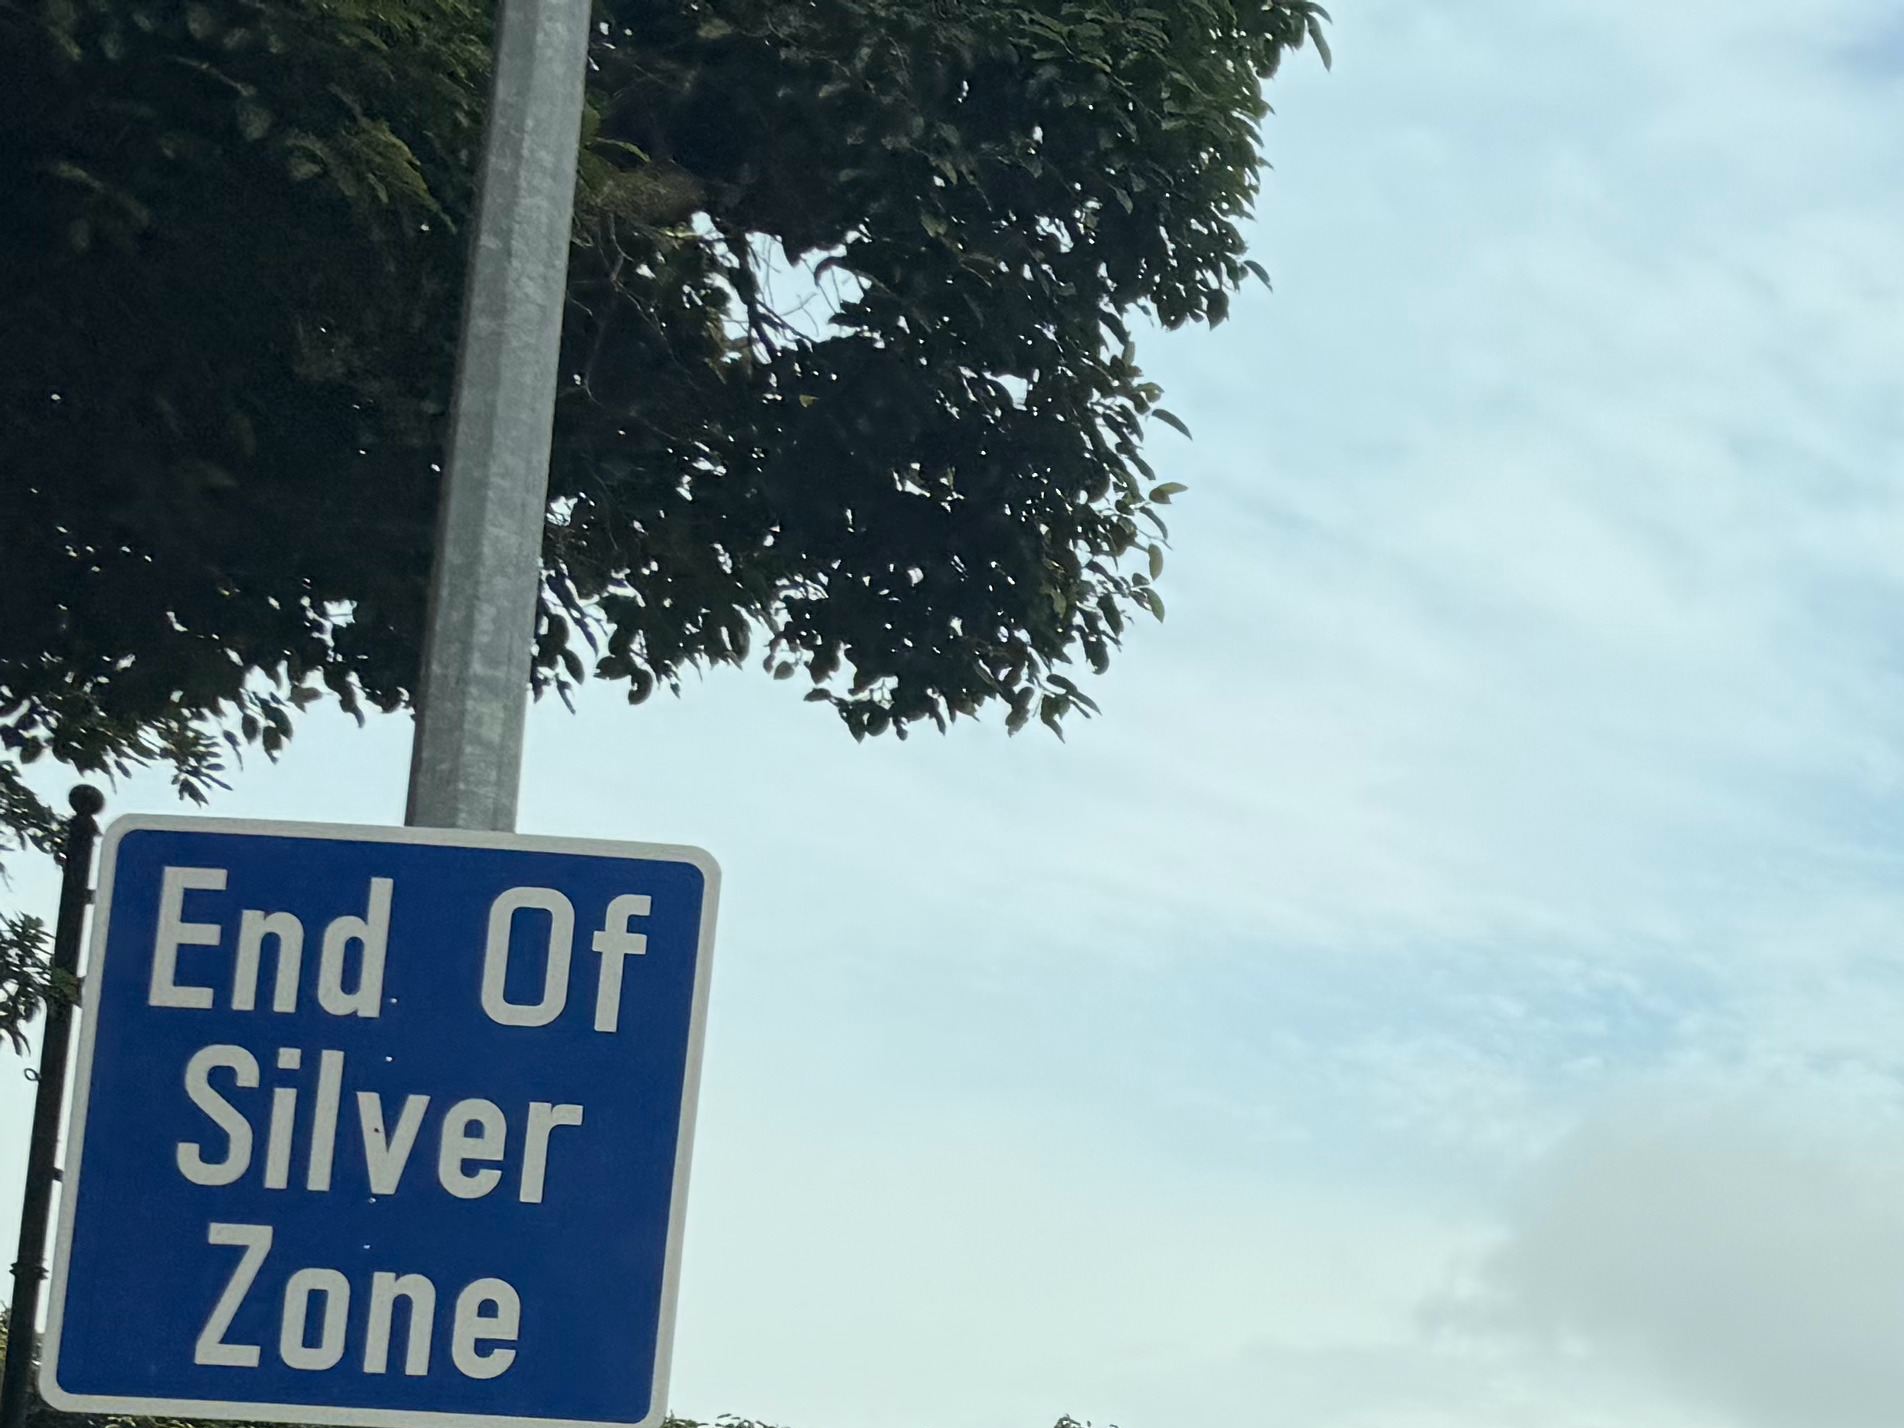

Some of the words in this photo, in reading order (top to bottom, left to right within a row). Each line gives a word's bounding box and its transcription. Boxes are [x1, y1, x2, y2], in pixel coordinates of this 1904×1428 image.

[148, 866, 394, 1018] End
[480, 886, 653, 1033] Of
[176, 1044, 584, 1204] Silver
[194, 1222, 521, 1379] Zone
